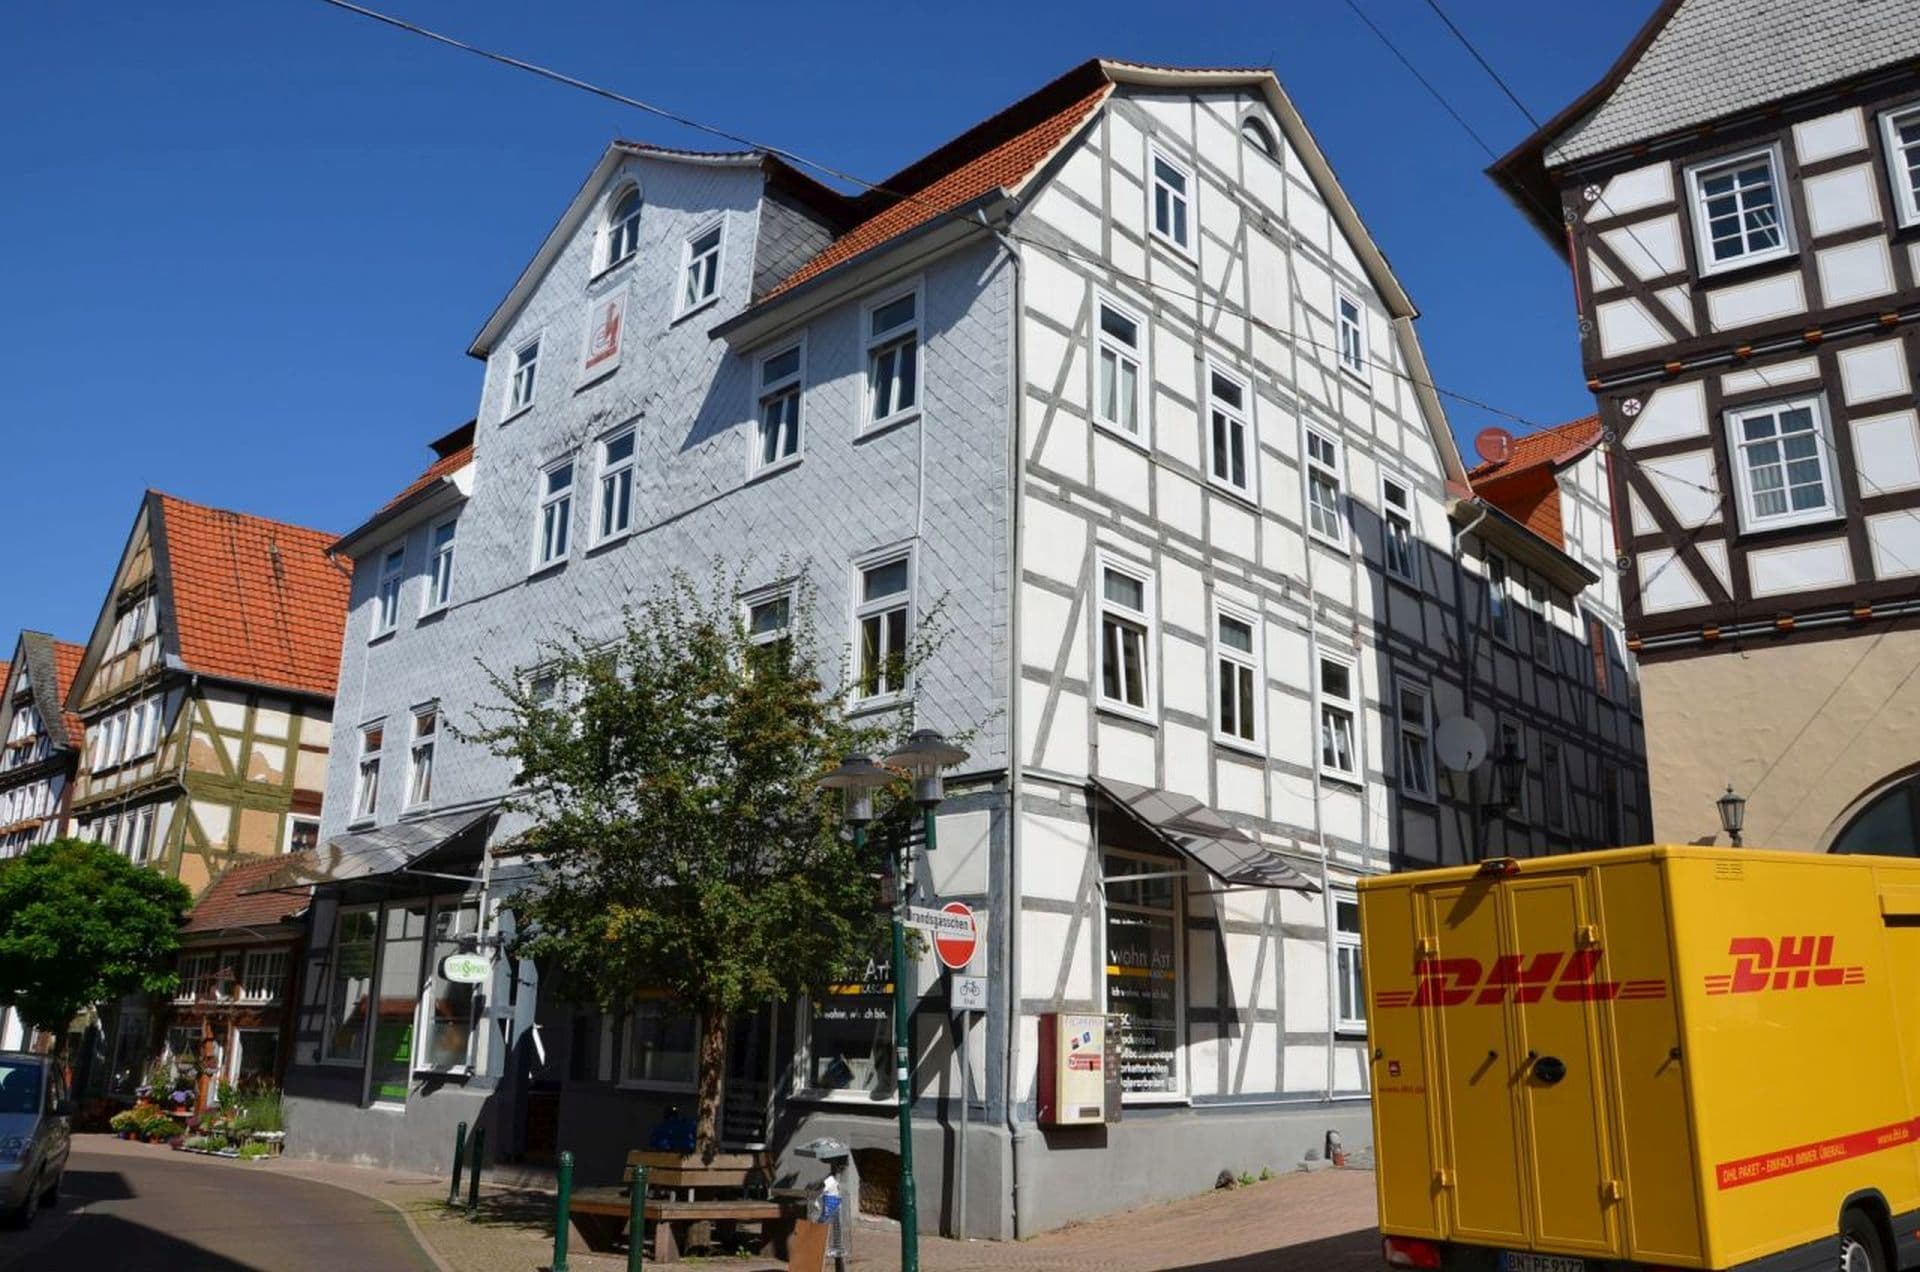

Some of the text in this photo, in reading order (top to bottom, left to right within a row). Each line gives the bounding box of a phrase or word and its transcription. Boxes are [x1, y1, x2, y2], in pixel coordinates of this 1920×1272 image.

[1411, 949, 1620, 1007] DHL
[1728, 936, 1845, 993] DHL
[1723, 1167, 1738, 1183] DHL
[1738, 1162, 1761, 1180] PAKET
